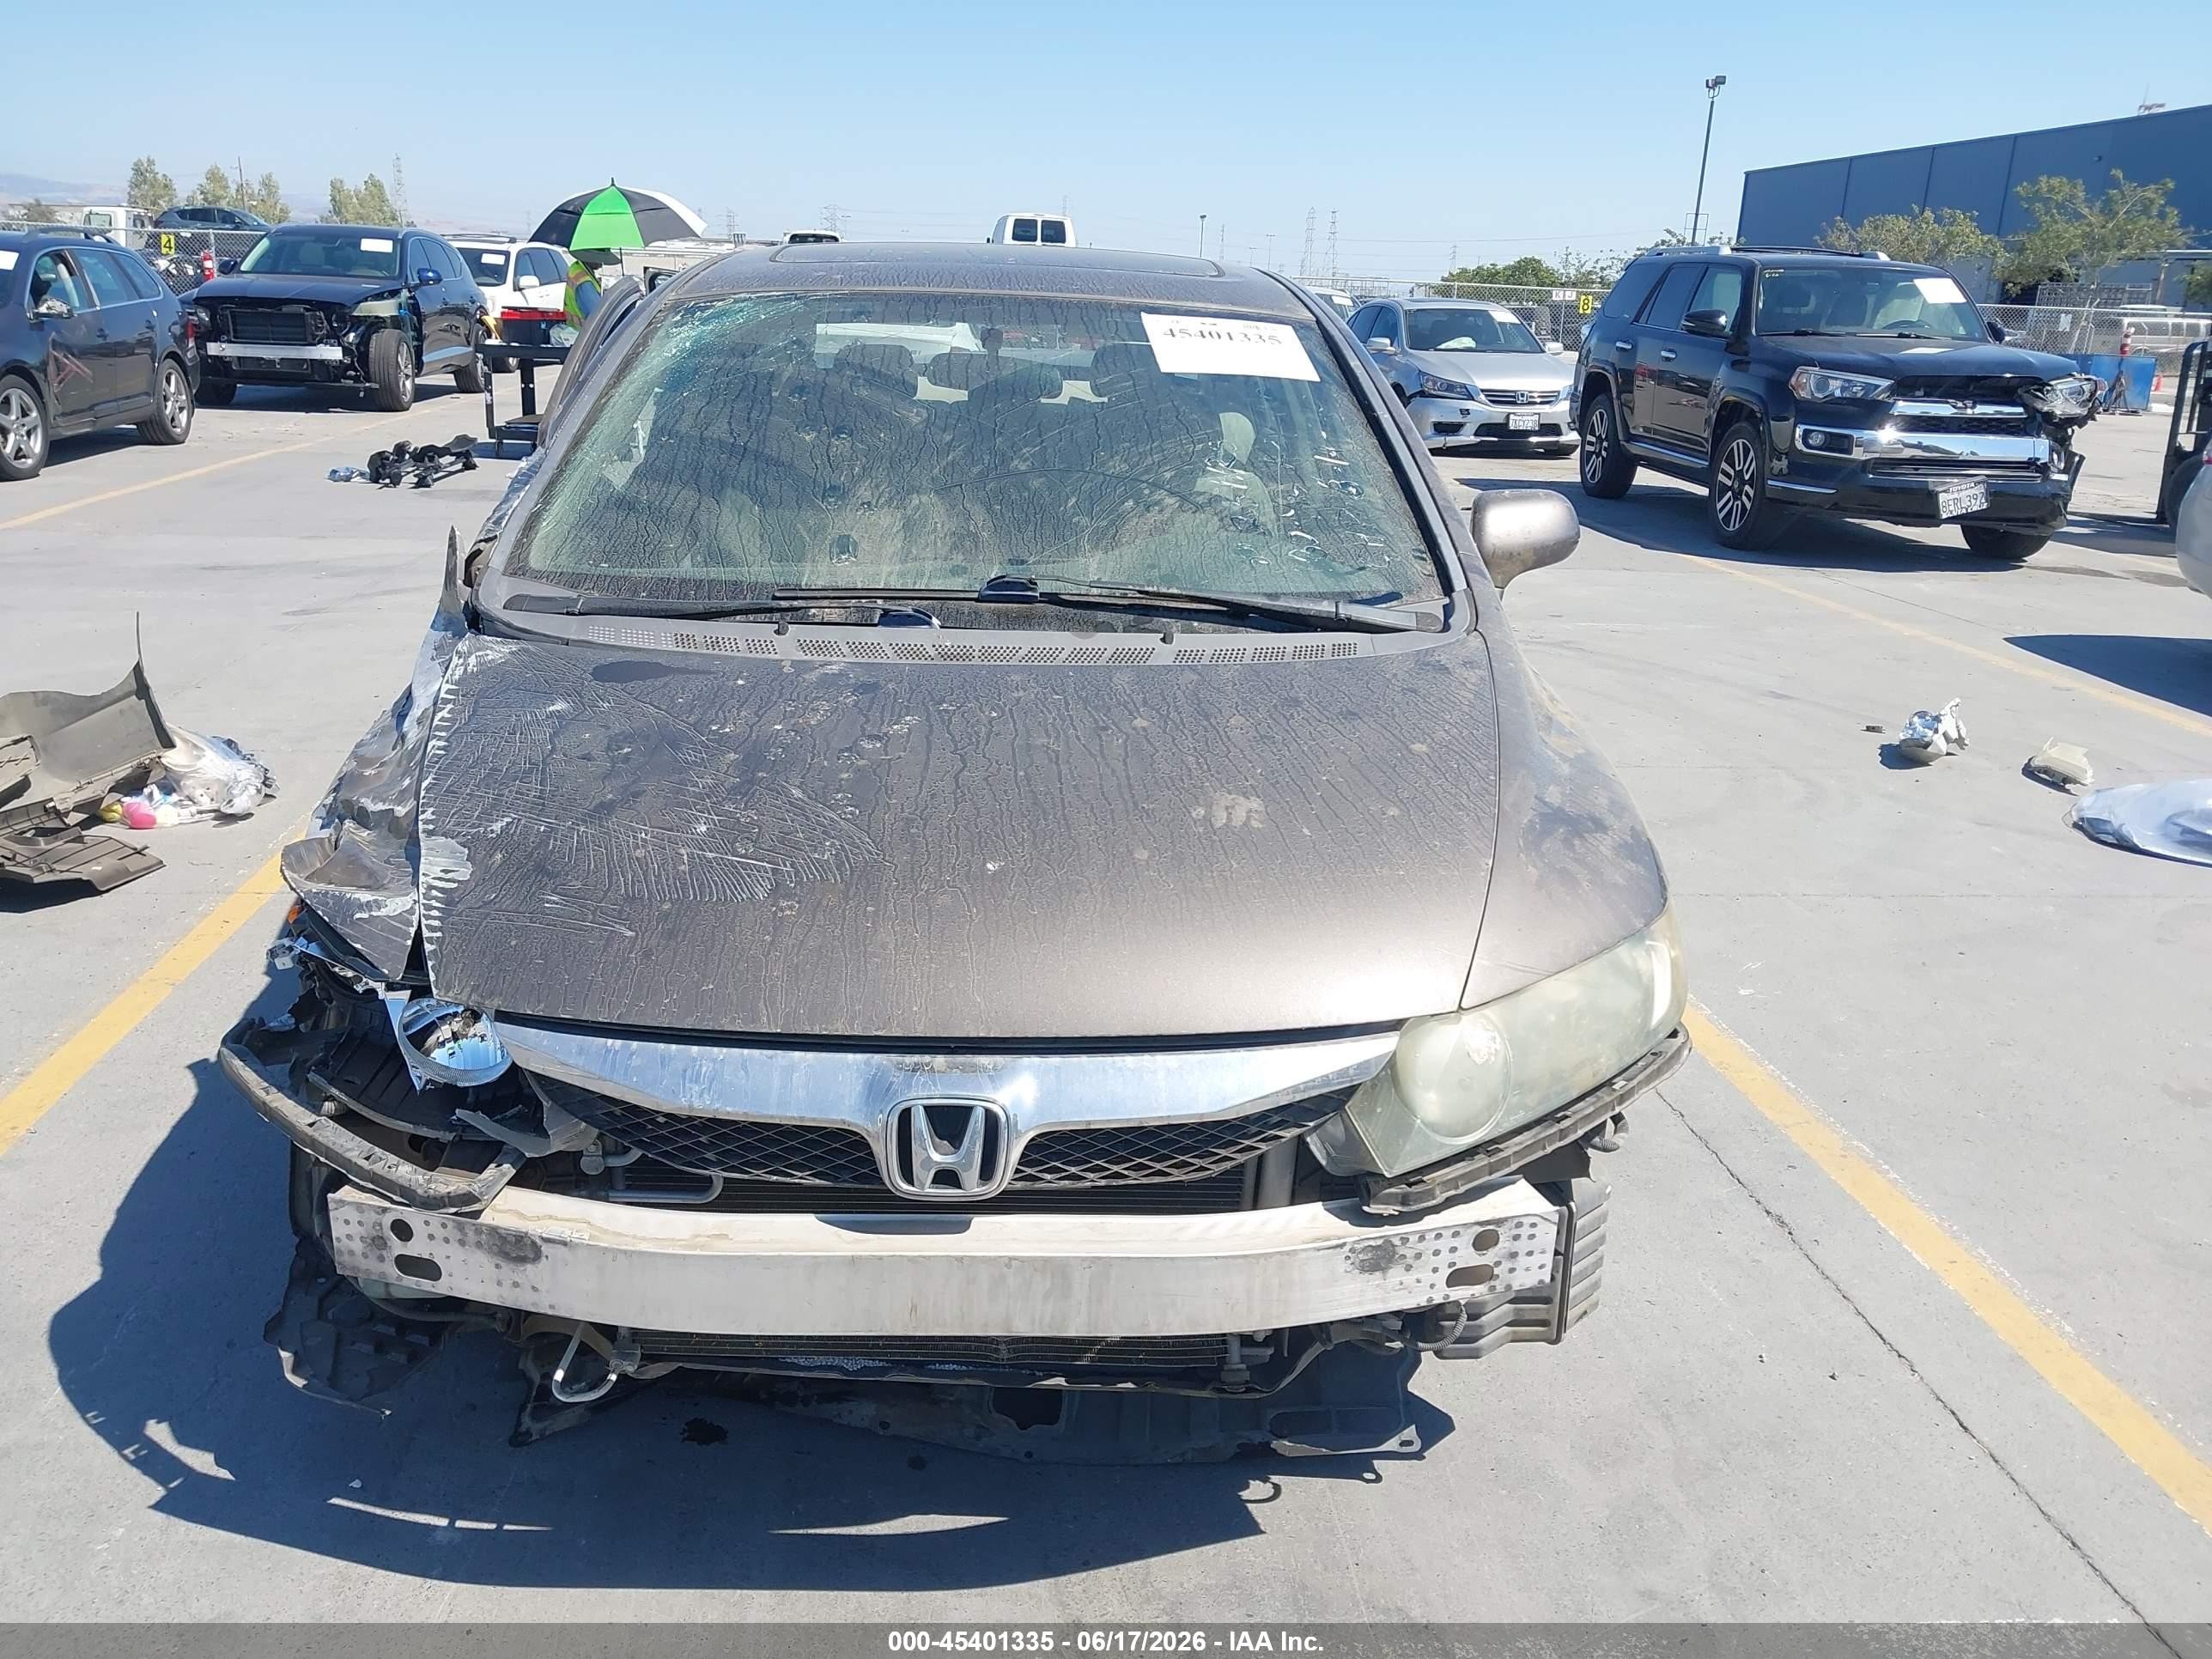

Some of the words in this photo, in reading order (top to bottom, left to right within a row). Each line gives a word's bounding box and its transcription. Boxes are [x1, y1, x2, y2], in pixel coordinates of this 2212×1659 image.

[163, 236, 173, 252] 4
[1582, 298, 1589, 311] 8
[1163, 327, 1283, 345] 45401335
[1948, 482, 1976, 493] TOYOTA
